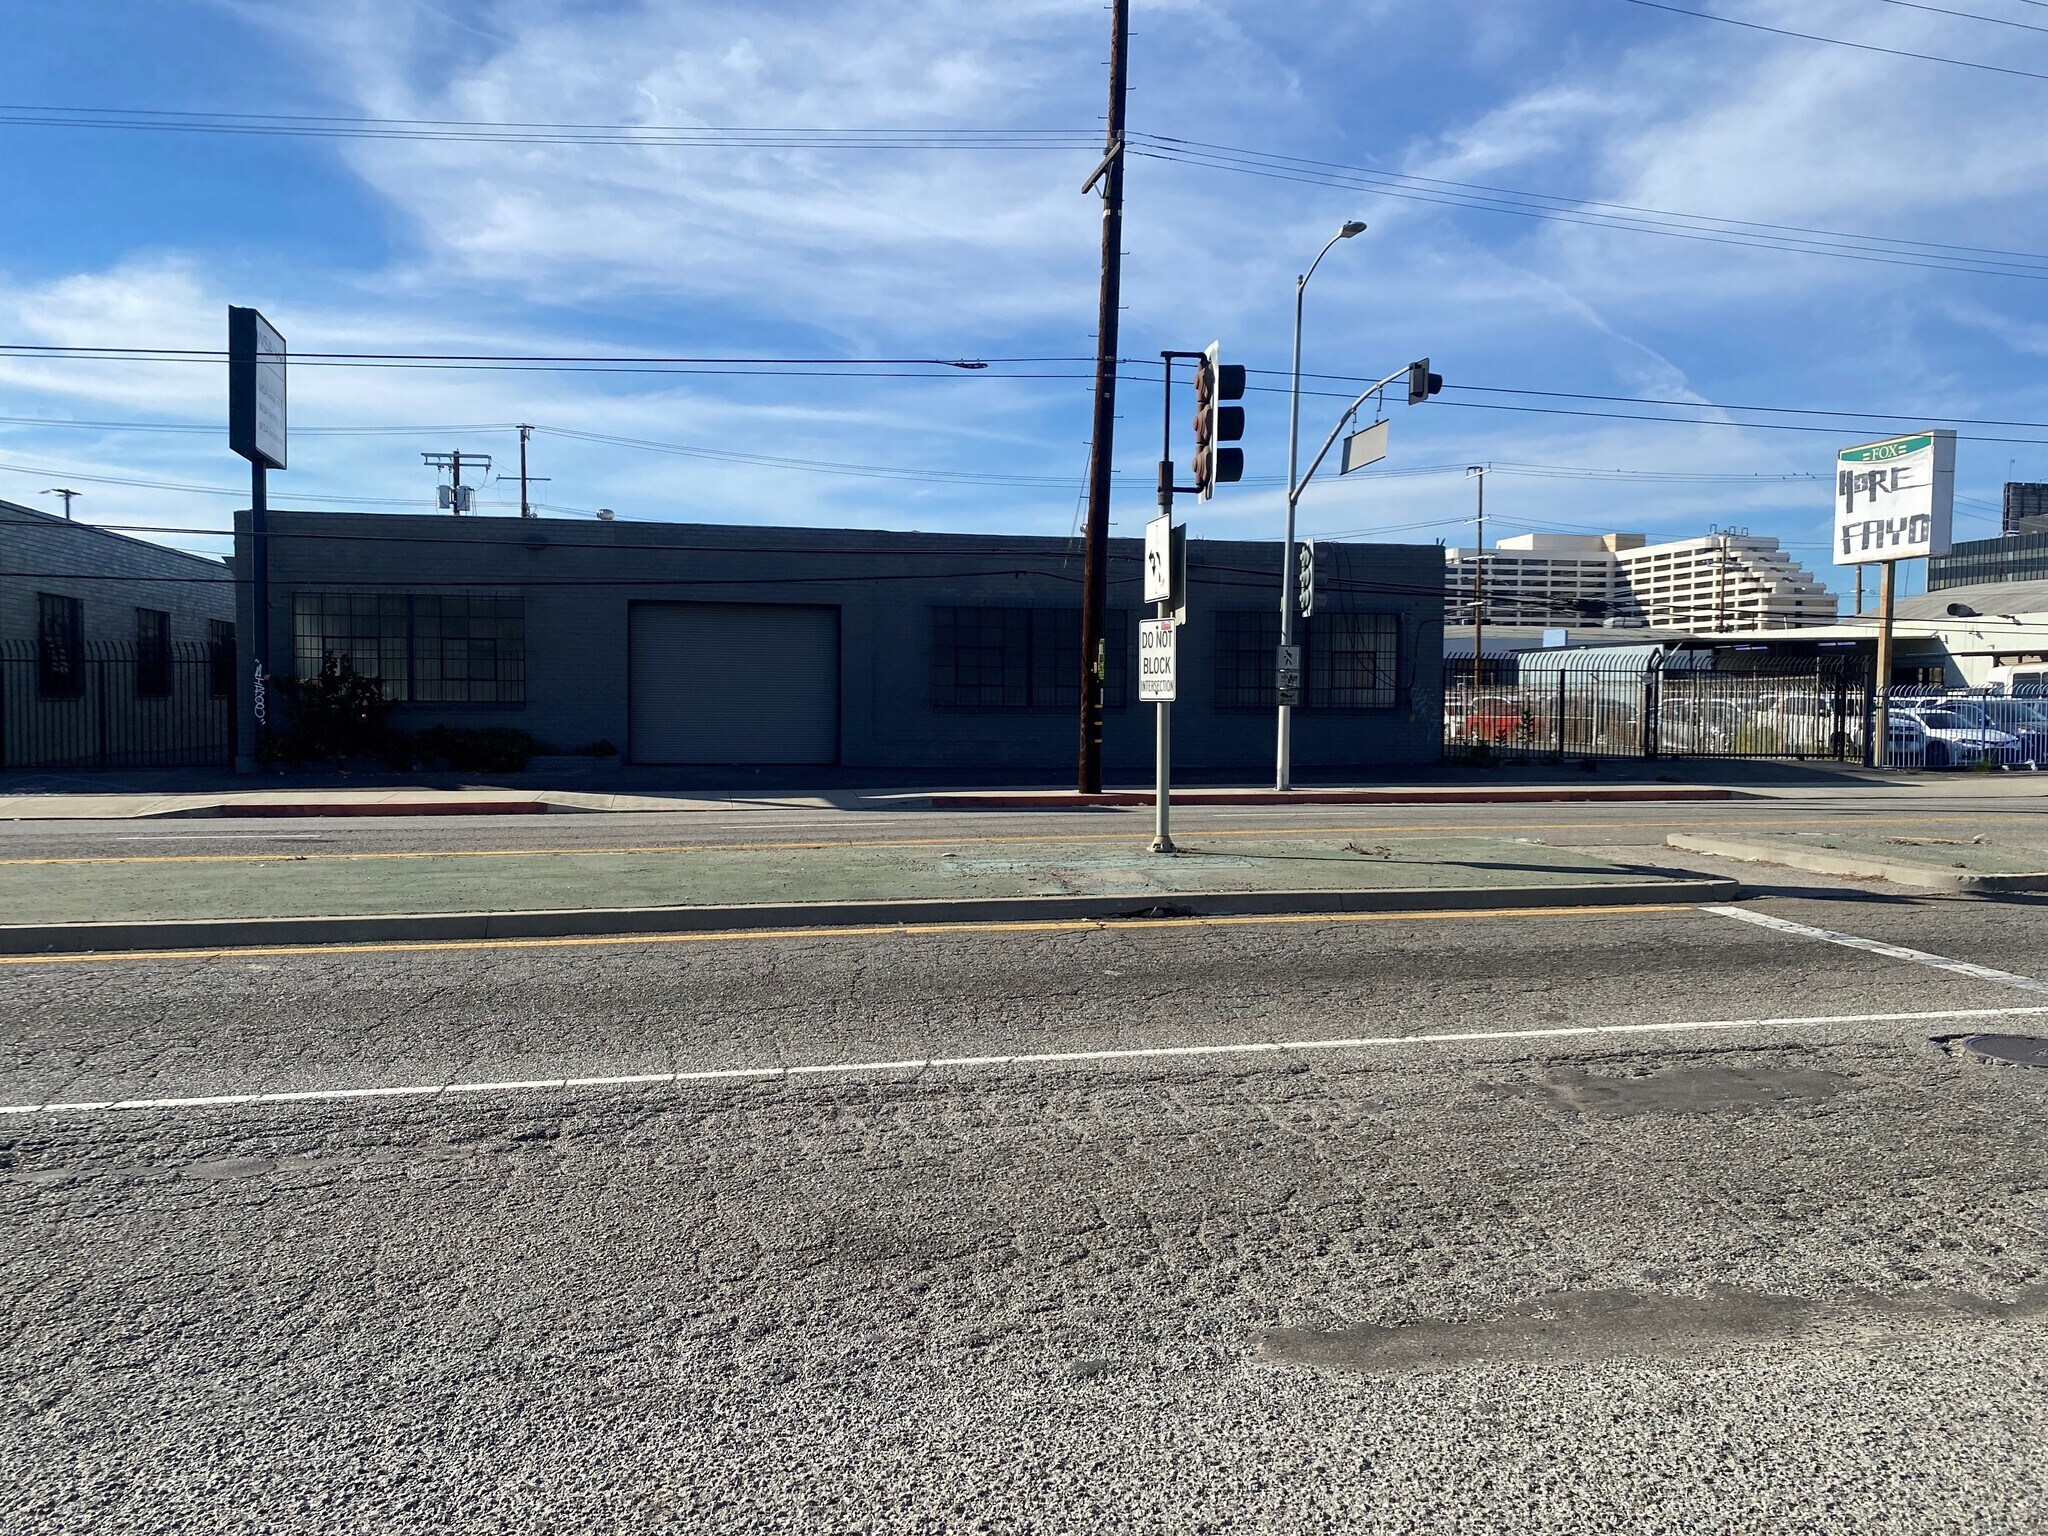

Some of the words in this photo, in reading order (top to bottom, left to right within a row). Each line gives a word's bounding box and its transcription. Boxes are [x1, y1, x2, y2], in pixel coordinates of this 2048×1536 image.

[1871, 444, 1899, 460] FOX
[1142, 631, 1154, 649] DO
[1156, 630, 1173, 648] NOT
[1143, 656, 1171, 674] BLOCK
[1140, 680, 1174, 692] INTERSECTION
